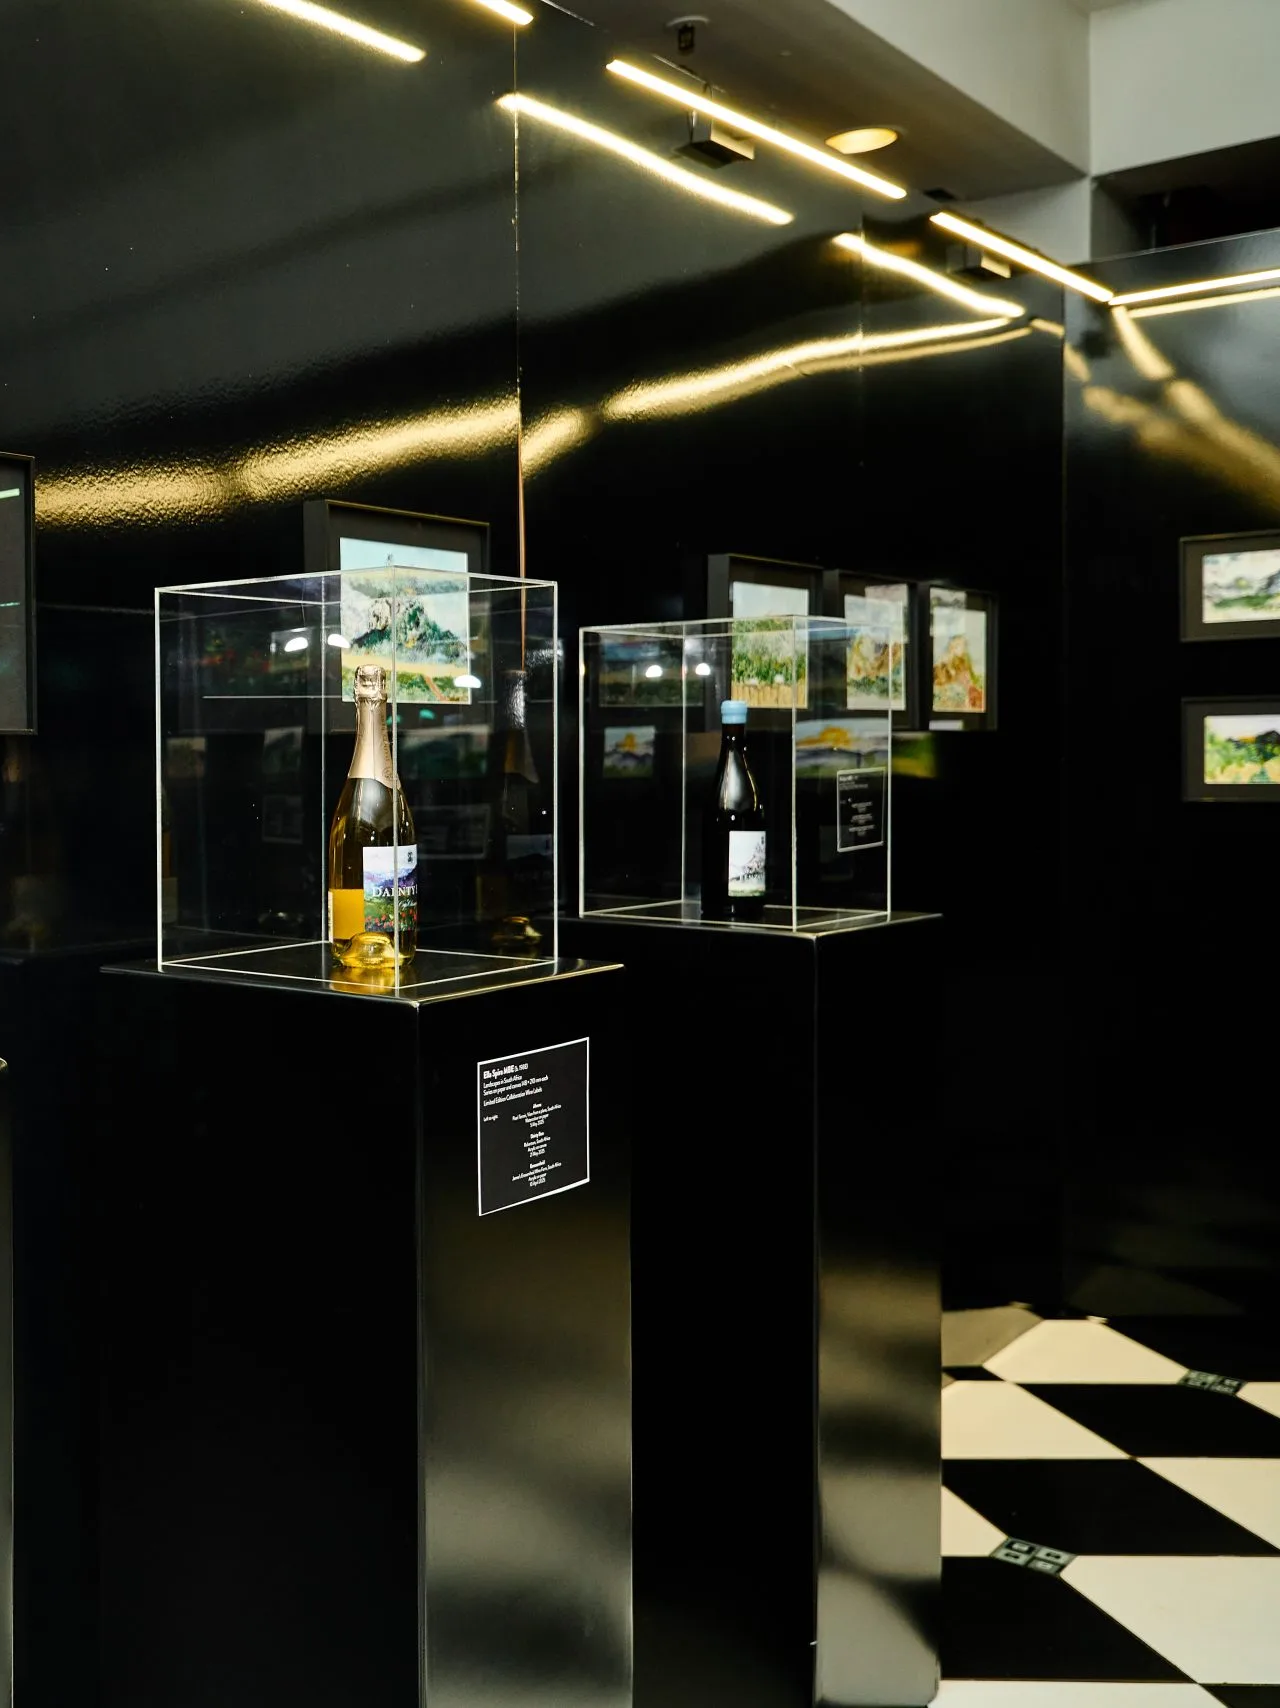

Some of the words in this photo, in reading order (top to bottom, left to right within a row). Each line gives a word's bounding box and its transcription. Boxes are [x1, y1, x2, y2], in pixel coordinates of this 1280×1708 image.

[483, 1071, 491, 1079] Ella
[503, 1065, 514, 1074] MBE
[483, 1081, 500, 1089] Landscapes
[483, 1098, 495, 1106] Limited
[496, 1096, 506, 1104] Edition
[506, 1092, 525, 1100] Collaboration
